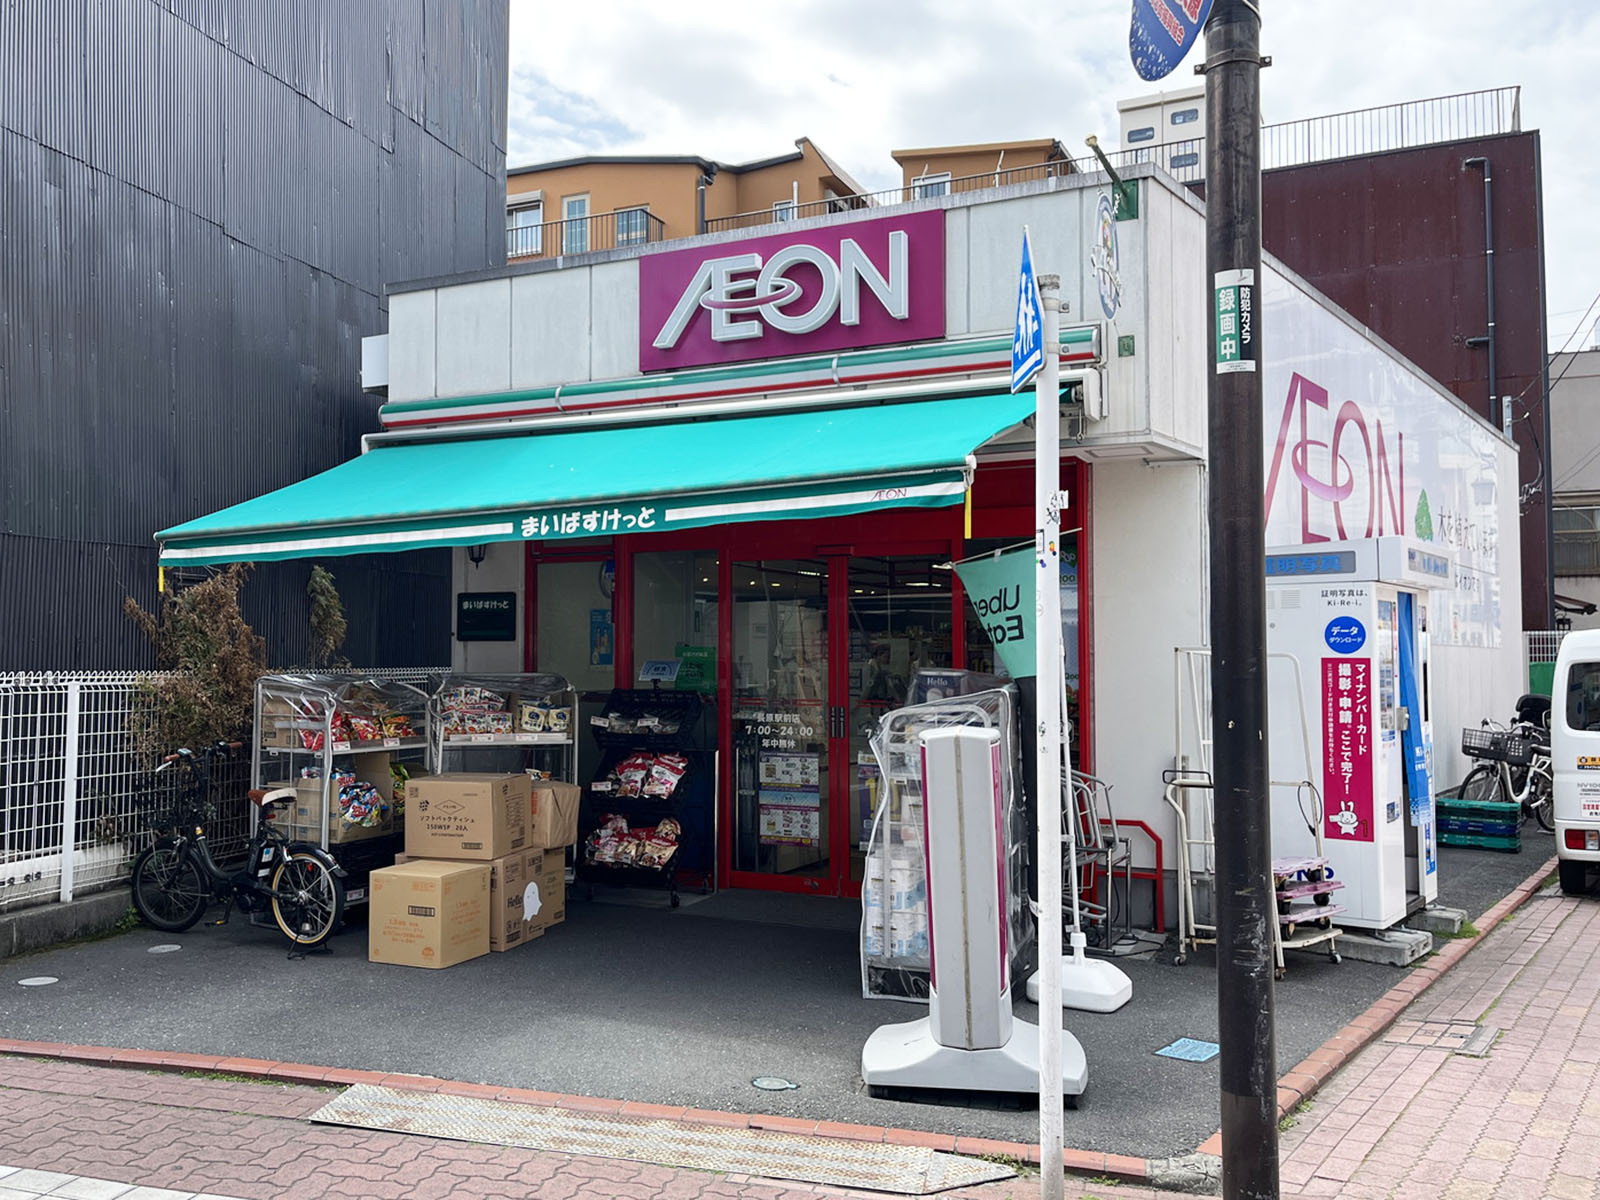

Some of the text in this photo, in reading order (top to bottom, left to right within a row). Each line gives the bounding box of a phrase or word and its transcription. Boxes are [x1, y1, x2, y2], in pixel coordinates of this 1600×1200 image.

[1219, 288, 1237, 360] 録画中
[1240, 286, 1251, 344] 防犯カメラ
[521, 507, 655, 537] まいばすけっと
[463, 600, 509, 609] まいばすけっと
[1329, 636, 1363, 645] ダウンロード
[1331, 626, 1359, 636] データ
[1355, 664, 1368, 755] マイナンバーカード
